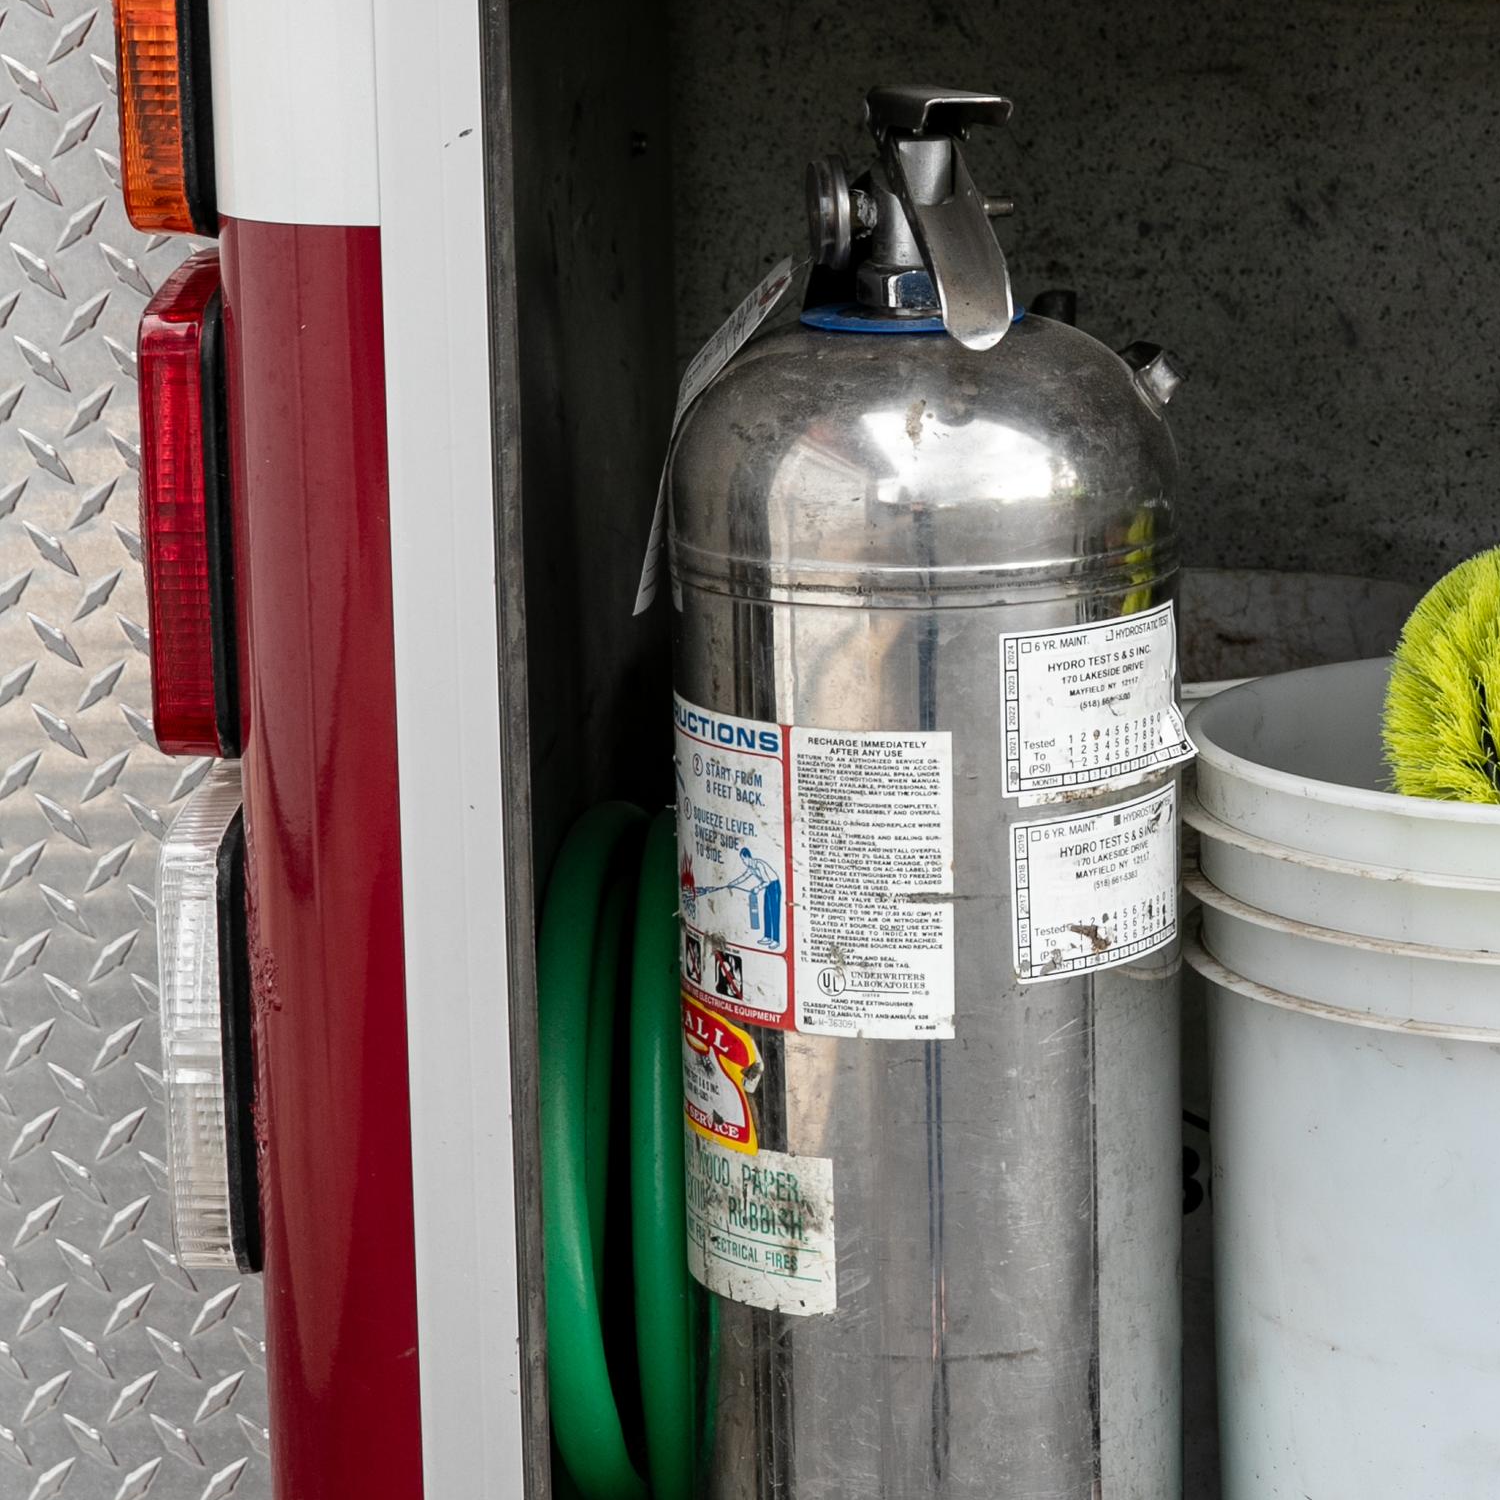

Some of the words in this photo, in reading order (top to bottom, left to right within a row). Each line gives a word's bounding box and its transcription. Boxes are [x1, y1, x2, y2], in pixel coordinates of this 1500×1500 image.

[1115, 618, 1158, 640] HYDROSTATIC
[1034, 643, 1040, 651] 6
[1043, 640, 1058, 650] YR.
[1060, 635, 1090, 649] MAINT.
[1048, 658, 1086, 672] HYDRO
[1089, 654, 1111, 668] TEST
[1113, 652, 1119, 661] S
[1121, 649, 1127, 659] &
[1129, 648, 1135, 657] S
[1062, 675, 1078, 684] 170
[1079, 666, 1120, 682] LAKESIDE
[1123, 661, 1144, 673] DRIVE
[1069, 684, 1105, 696] MAYFIELD
[1108, 682, 1116, 690] NY
[1121, 677, 1138, 686] 12117
[1008, 706, 1016, 726] 2022
[808, 737, 858, 746] RECHARGE
[861, 740, 927, 749] IMMEDIATELY
[830, 748, 859, 756] AFTER
[1009, 737, 1017, 757] 2021
[1024, 740, 1055, 750] Tested
[1034, 752, 1046, 760] To
[706, 763, 731, 781] START
[735, 771, 762, 788] FROM
[1029, 764, 1051, 774] (PSI)
[1032, 777, 1058, 787] MONTH
[706, 780, 710, 793] 8
[713, 781, 731, 799] FEET
[736, 788, 765, 807] BACK.
[693, 806, 723, 829] SQUEEZE
[726, 817, 757, 837] LEVER.
[1044, 830, 1049, 839] 6
[1051, 828, 1067, 837] YR.
[1069, 821, 1097, 835] MAINT.
[695, 824, 718, 843] SWEEP
[720, 835, 739, 850] SIDE
[1060, 841, 1097, 858] HYDRO
[1100, 835, 1121, 849] TEST
[1124, 832, 1130, 843] S
[1131, 830, 1137, 840] &
[696, 842, 704, 857] TO
[1093, 847, 1129, 864] LAKESIDE
[1131, 840, 1148, 854] DRIVE
[1075, 861, 1116, 879] MAYFIELD
[1118, 859, 1129, 869] NY
[1133, 852, 1150, 864] 12117
[1093, 878, 1110, 891] (518)
[1019, 894, 1029, 914] 2017
[1020, 924, 1028, 943] 2016
[1035, 925, 1065, 936] Tested
[1045, 939, 1056, 947] To
[850, 971, 925, 980] UNDERWRITERS
[734, 1006, 781, 1023] EQUIPMENT
[765, 1251, 798, 1271] FIRES
